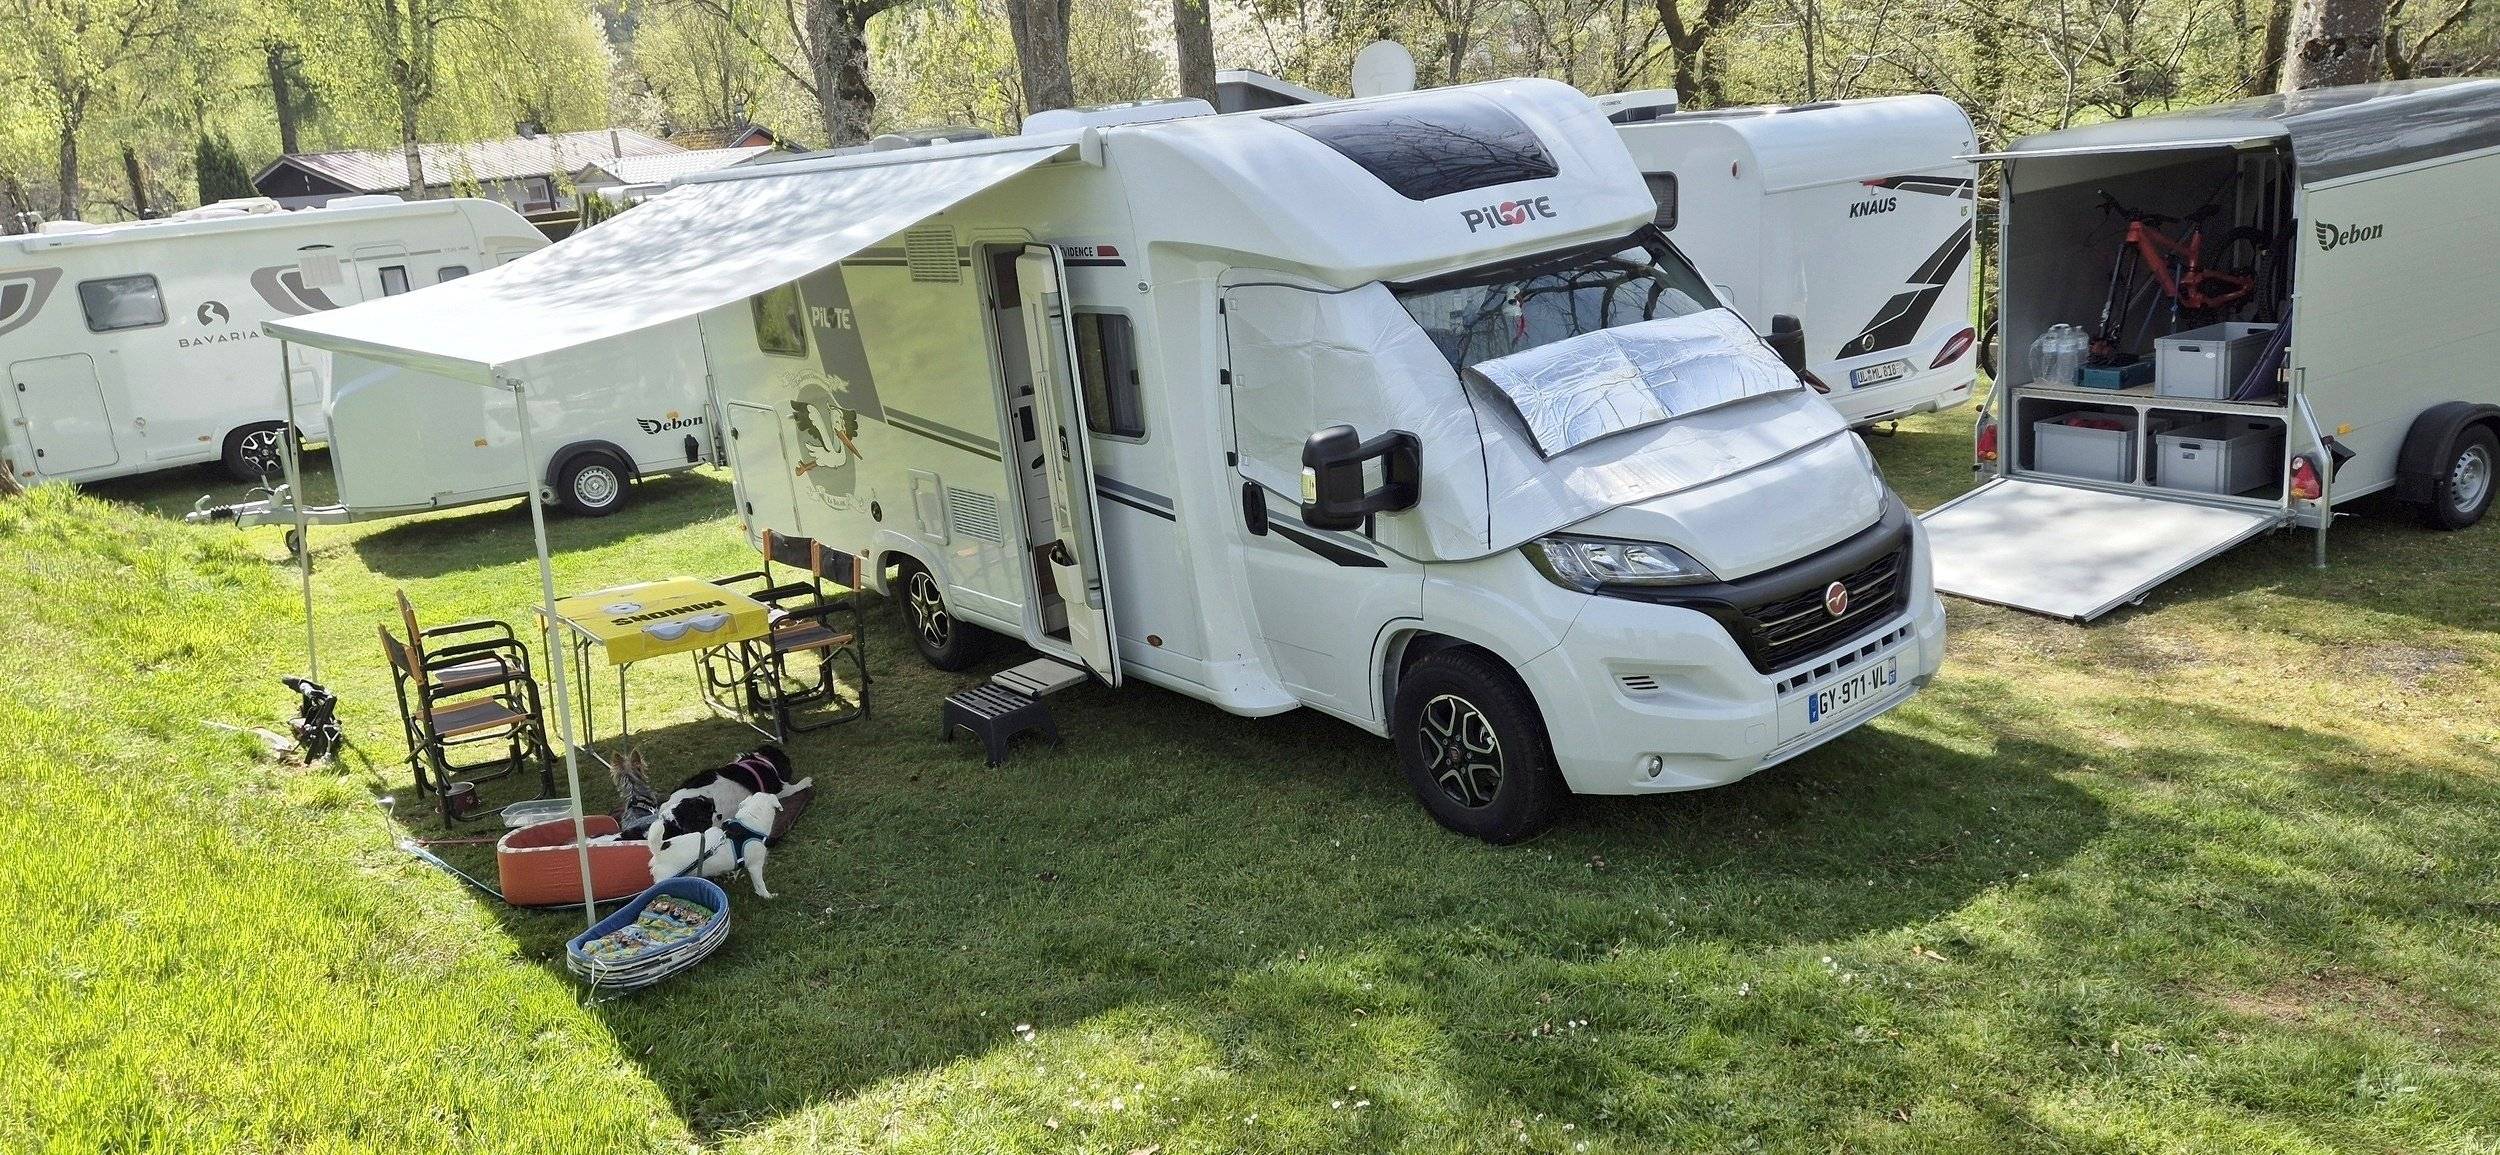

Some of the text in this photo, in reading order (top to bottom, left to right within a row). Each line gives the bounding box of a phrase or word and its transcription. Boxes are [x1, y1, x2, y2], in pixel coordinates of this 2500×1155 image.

[1849, 197, 1897, 218] KNAUS
[2315, 218, 2383, 251] Debon
[1061, 246, 1094, 257] VIDENCE
[179, 331, 259, 347] BAVARIA
[636, 416, 703, 435] Debon
[610, 600, 727, 626] MINIONS
[1820, 666, 1887, 715] GY-971-VL
